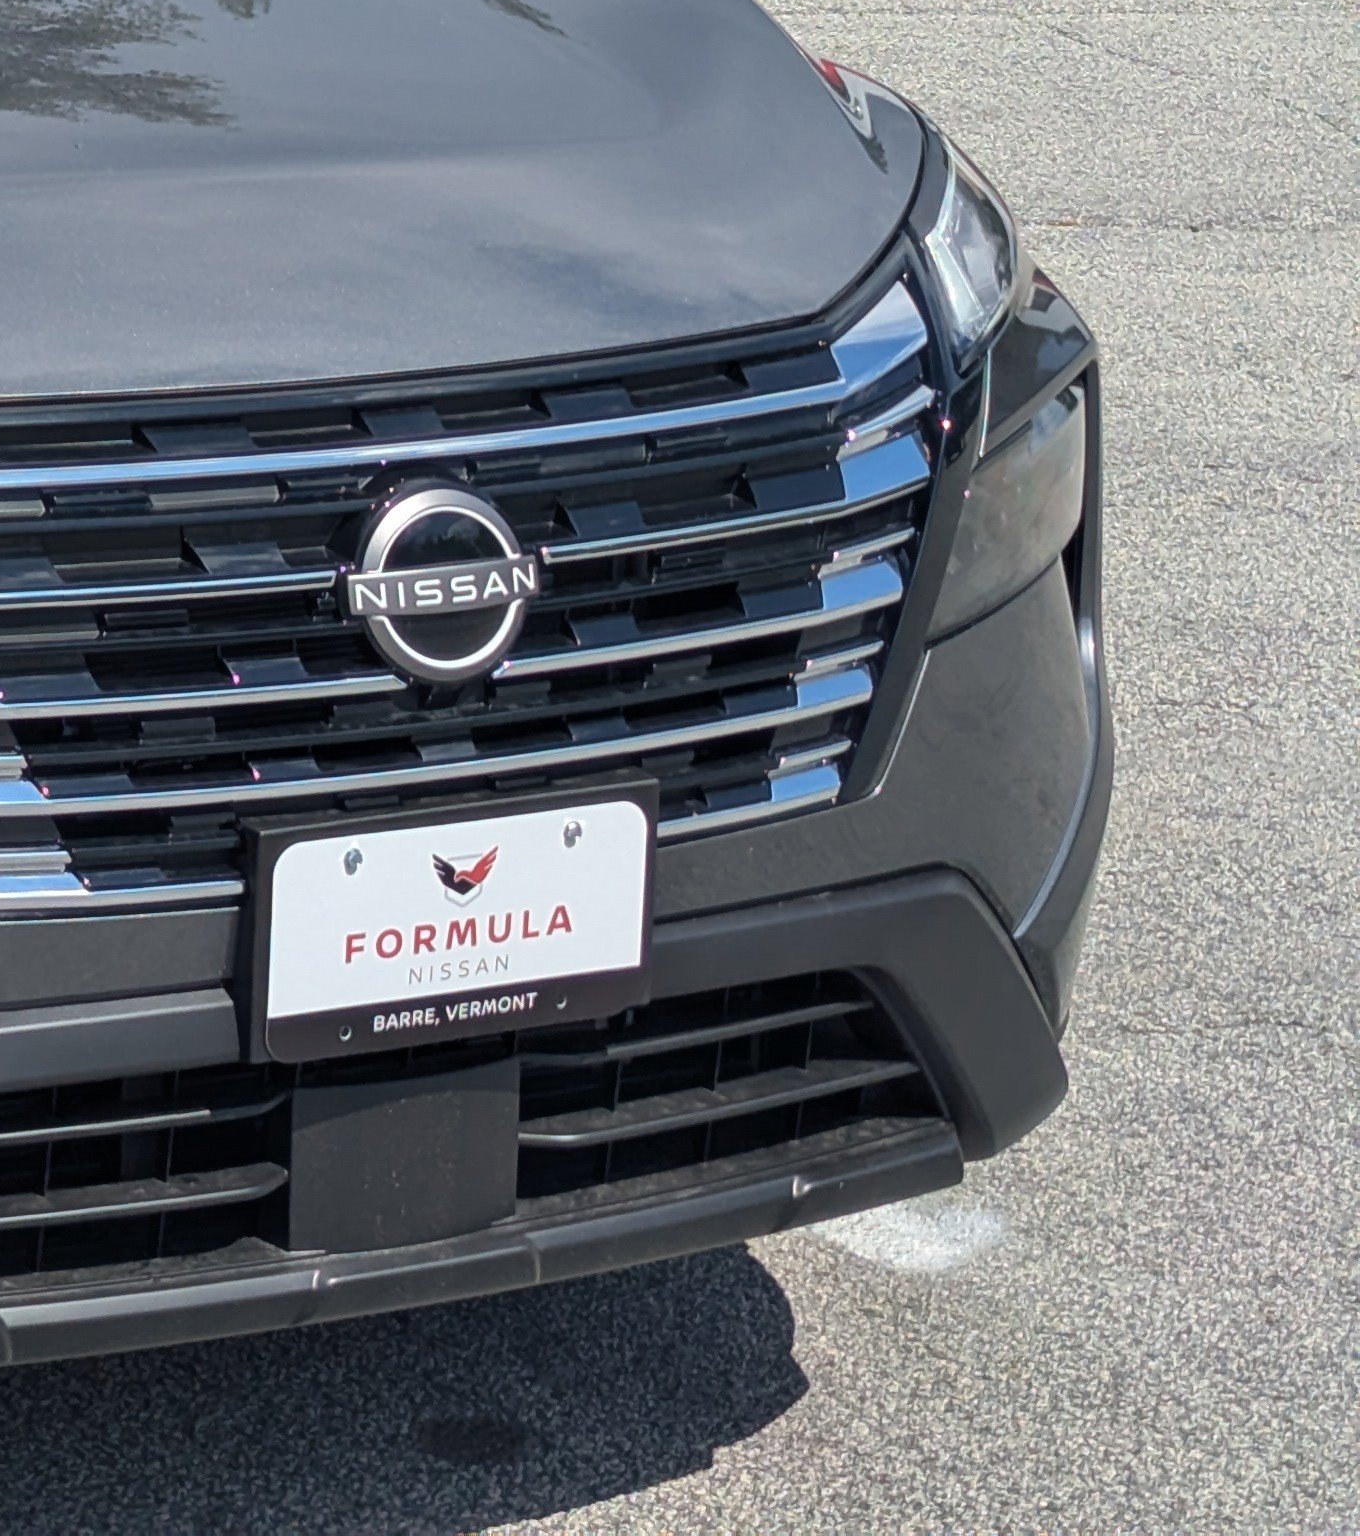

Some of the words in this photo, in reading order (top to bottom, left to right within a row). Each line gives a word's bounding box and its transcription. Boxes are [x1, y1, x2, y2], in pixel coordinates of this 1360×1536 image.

[354, 563, 536, 611] NISSAN
[344, 904, 574, 964] FORMULA
[407, 955, 511, 985] NISSAN
[373, 1006, 441, 1033] BARRE,
[445, 991, 539, 1022] VERMONT
